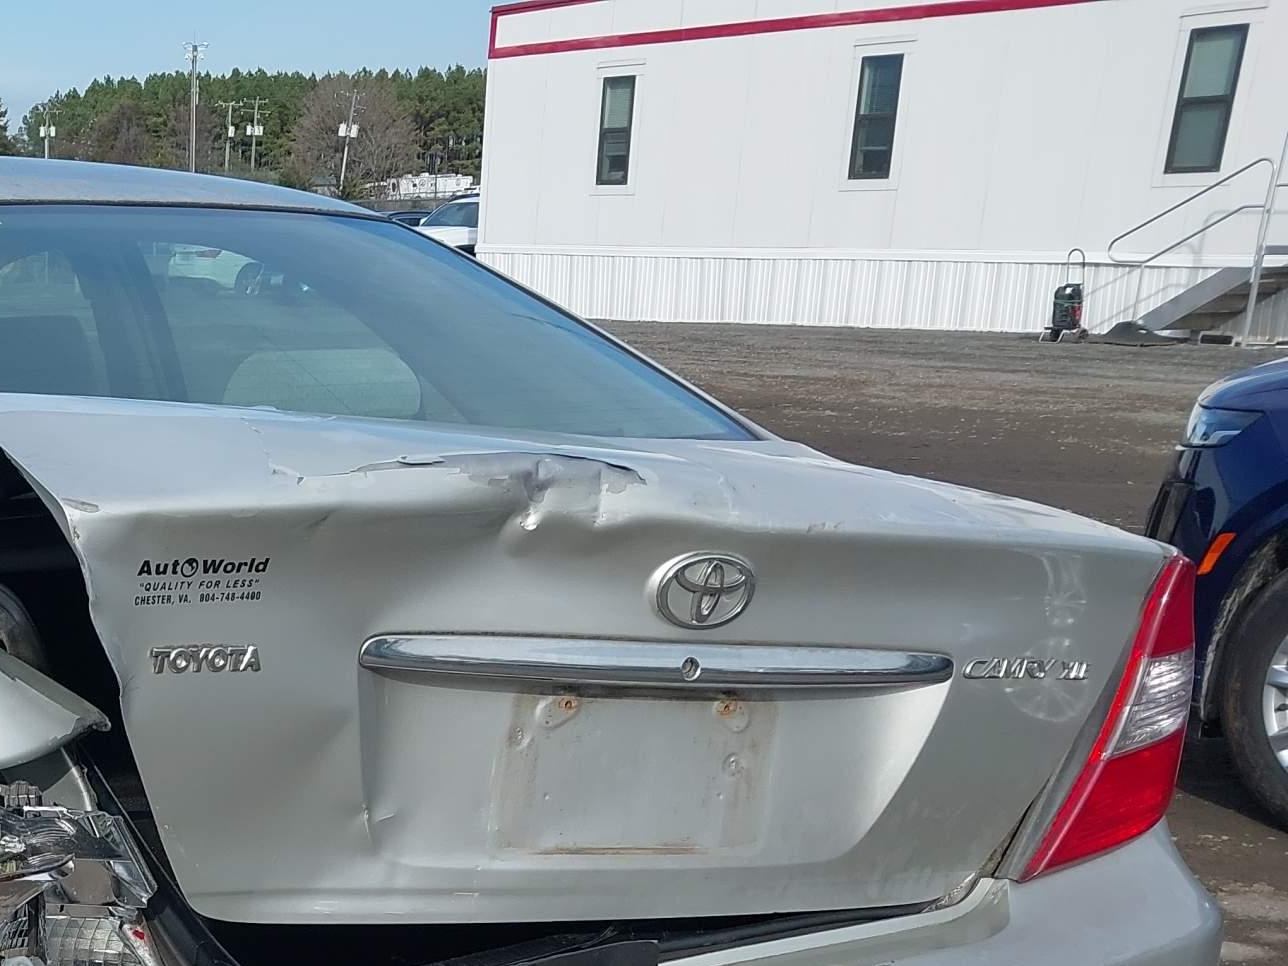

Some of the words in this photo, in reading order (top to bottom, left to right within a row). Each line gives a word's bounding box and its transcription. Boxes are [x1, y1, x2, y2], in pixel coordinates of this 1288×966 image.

[198, 579, 221, 590] FOR
[134, 593, 175, 607] CHESTER,
[178, 594, 192, 604] VA.
[150, 645, 261, 674] TOYOTA
[963, 657, 1057, 680] CAMRY
